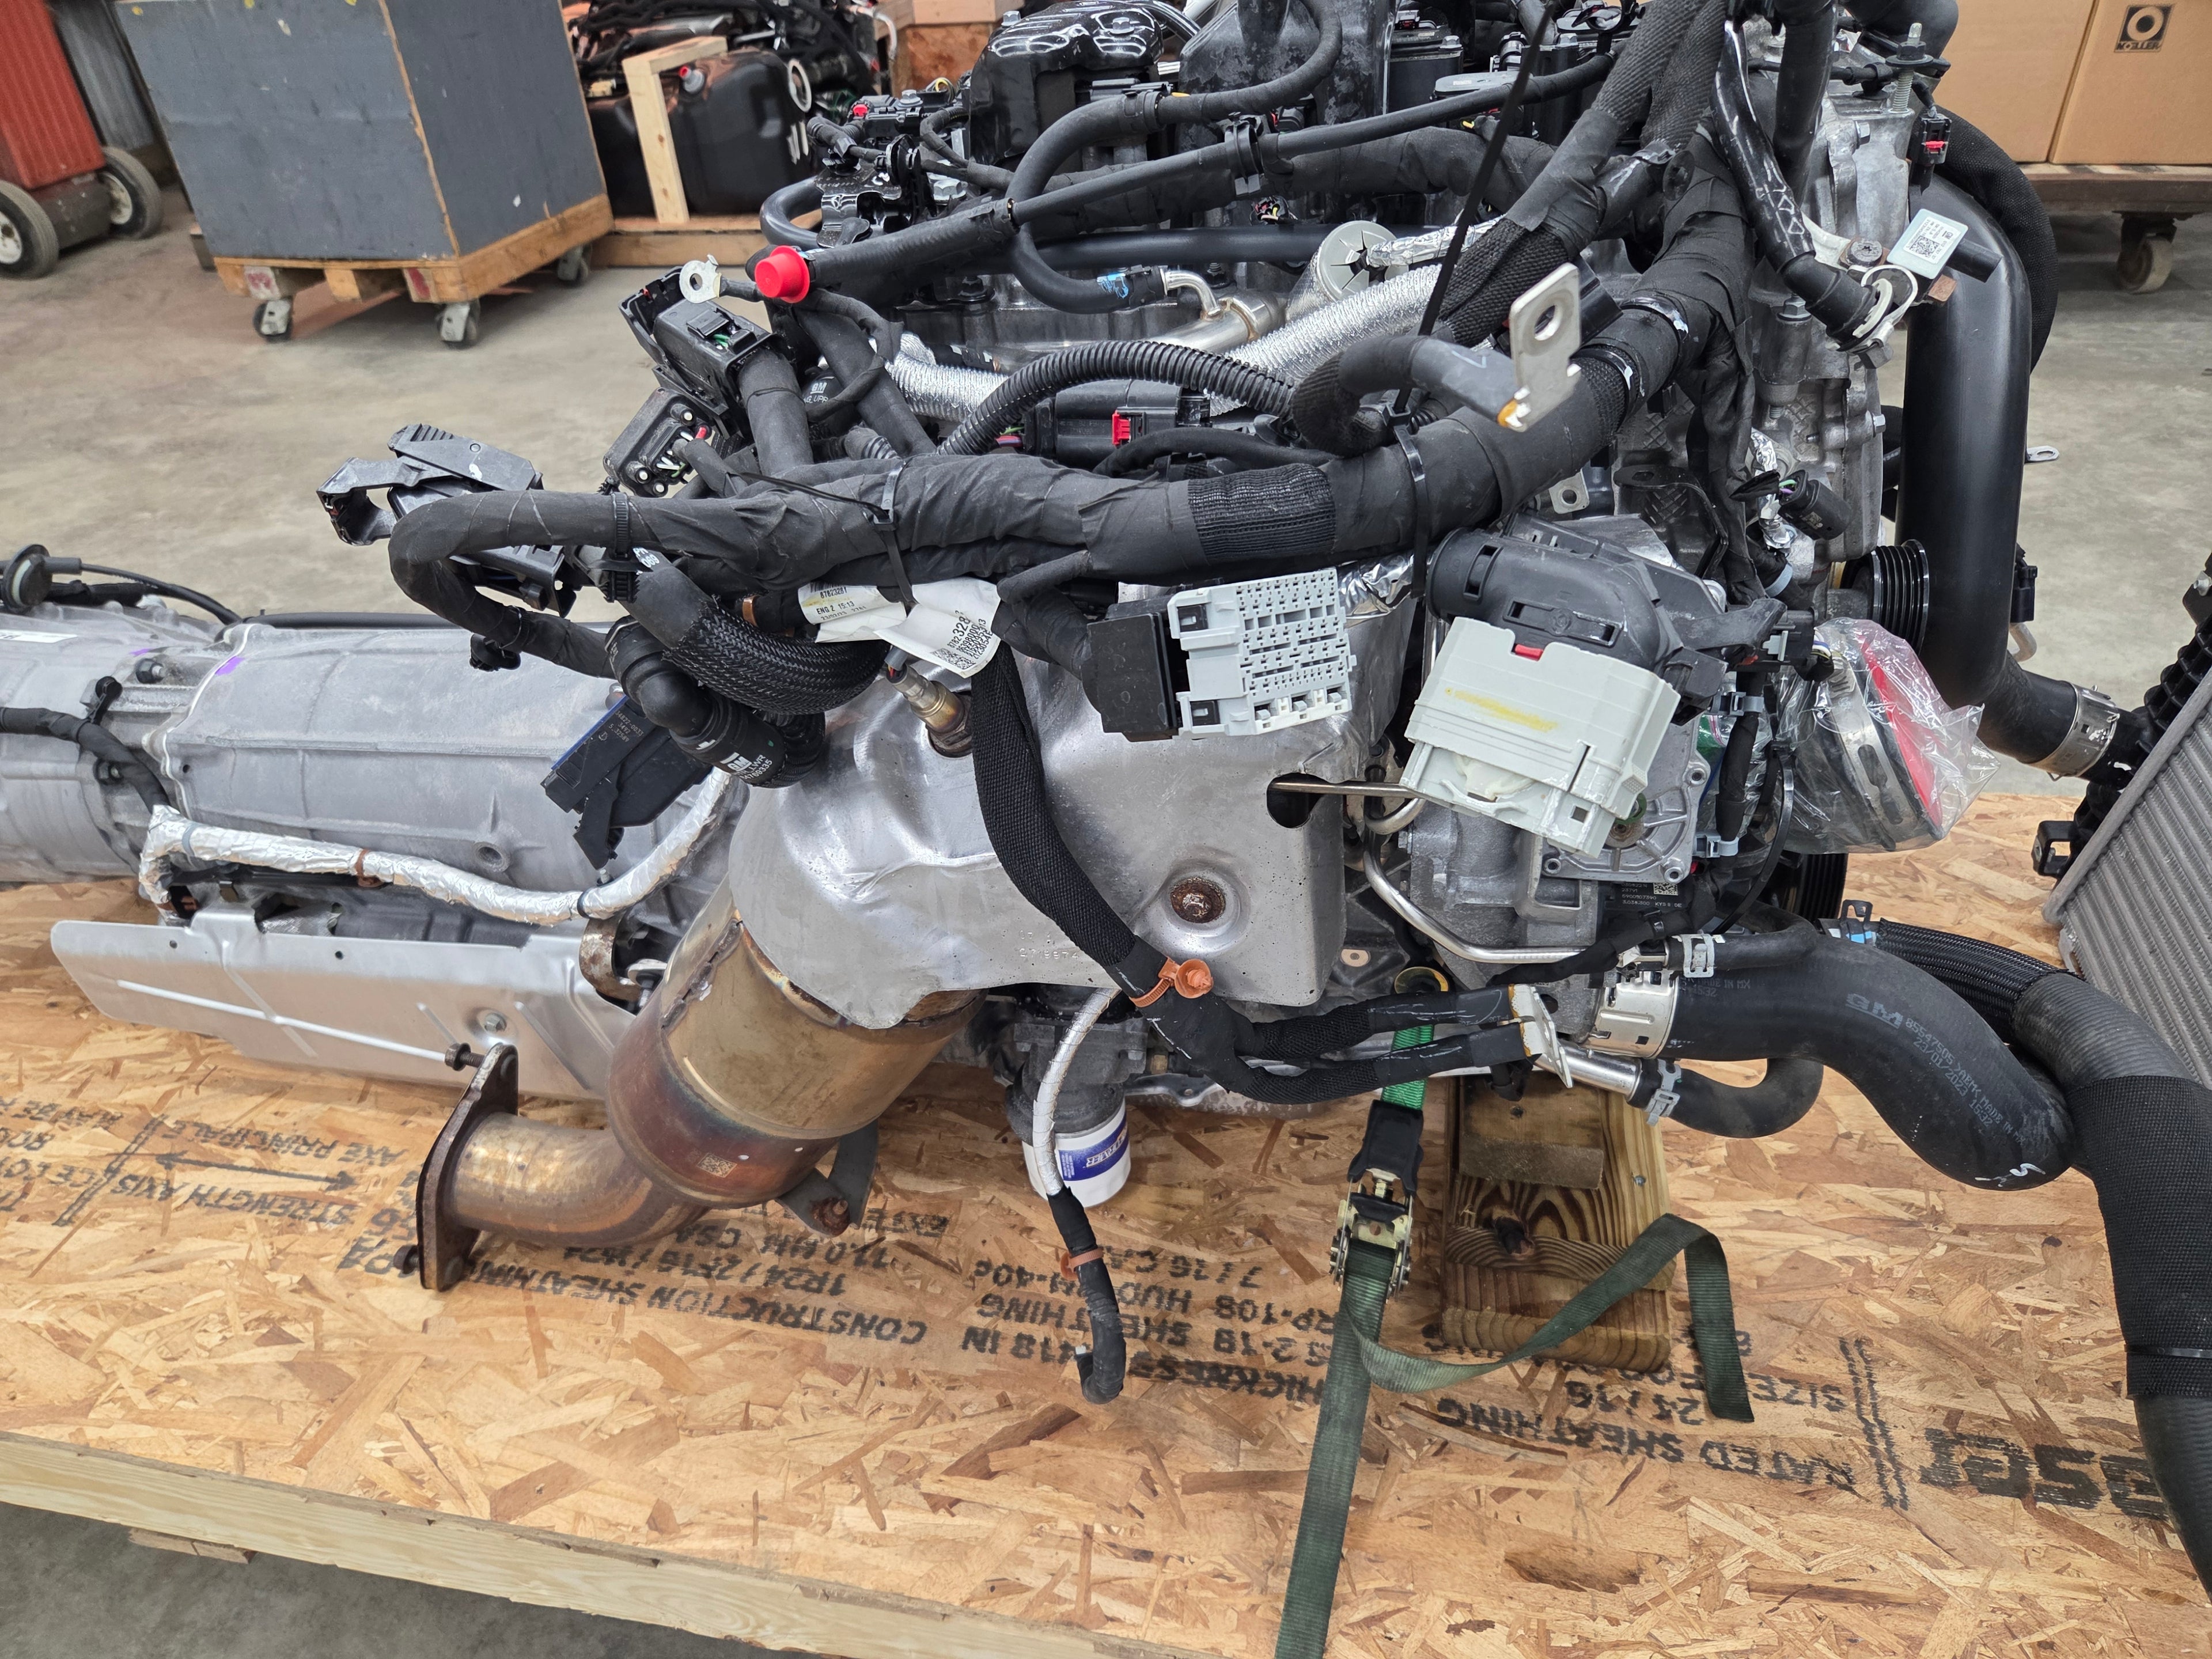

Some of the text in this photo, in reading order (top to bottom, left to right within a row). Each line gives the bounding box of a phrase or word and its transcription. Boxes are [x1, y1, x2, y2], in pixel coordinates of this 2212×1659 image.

[810, 382, 827, 394] GM
[816, 606, 830, 615] ENG
[838, 601, 855, 610] 15:13
[727, 756, 752, 772] GM
[1845, 993, 1903, 1029] GM
[1905, 1017, 1956, 1065] 85547505
[1980, 1096, 2005, 1124] MADE
[1912, 1036, 1994, 1127] 23/01/2023 15:32
[160, 1119, 409, 1168] AXE PRINCIPALE
[109, 1174, 188, 1202] AXIS
[190, 1182, 360, 1226] STRENGTH
[475, 1262, 927, 1344] CONSTRUCTION SHEATHIN
[976, 1293, 1192, 1347] SHETHING
[960, 1327, 1001, 1355] IN
[1435, 1397, 1685, 1464] SHEATHING
